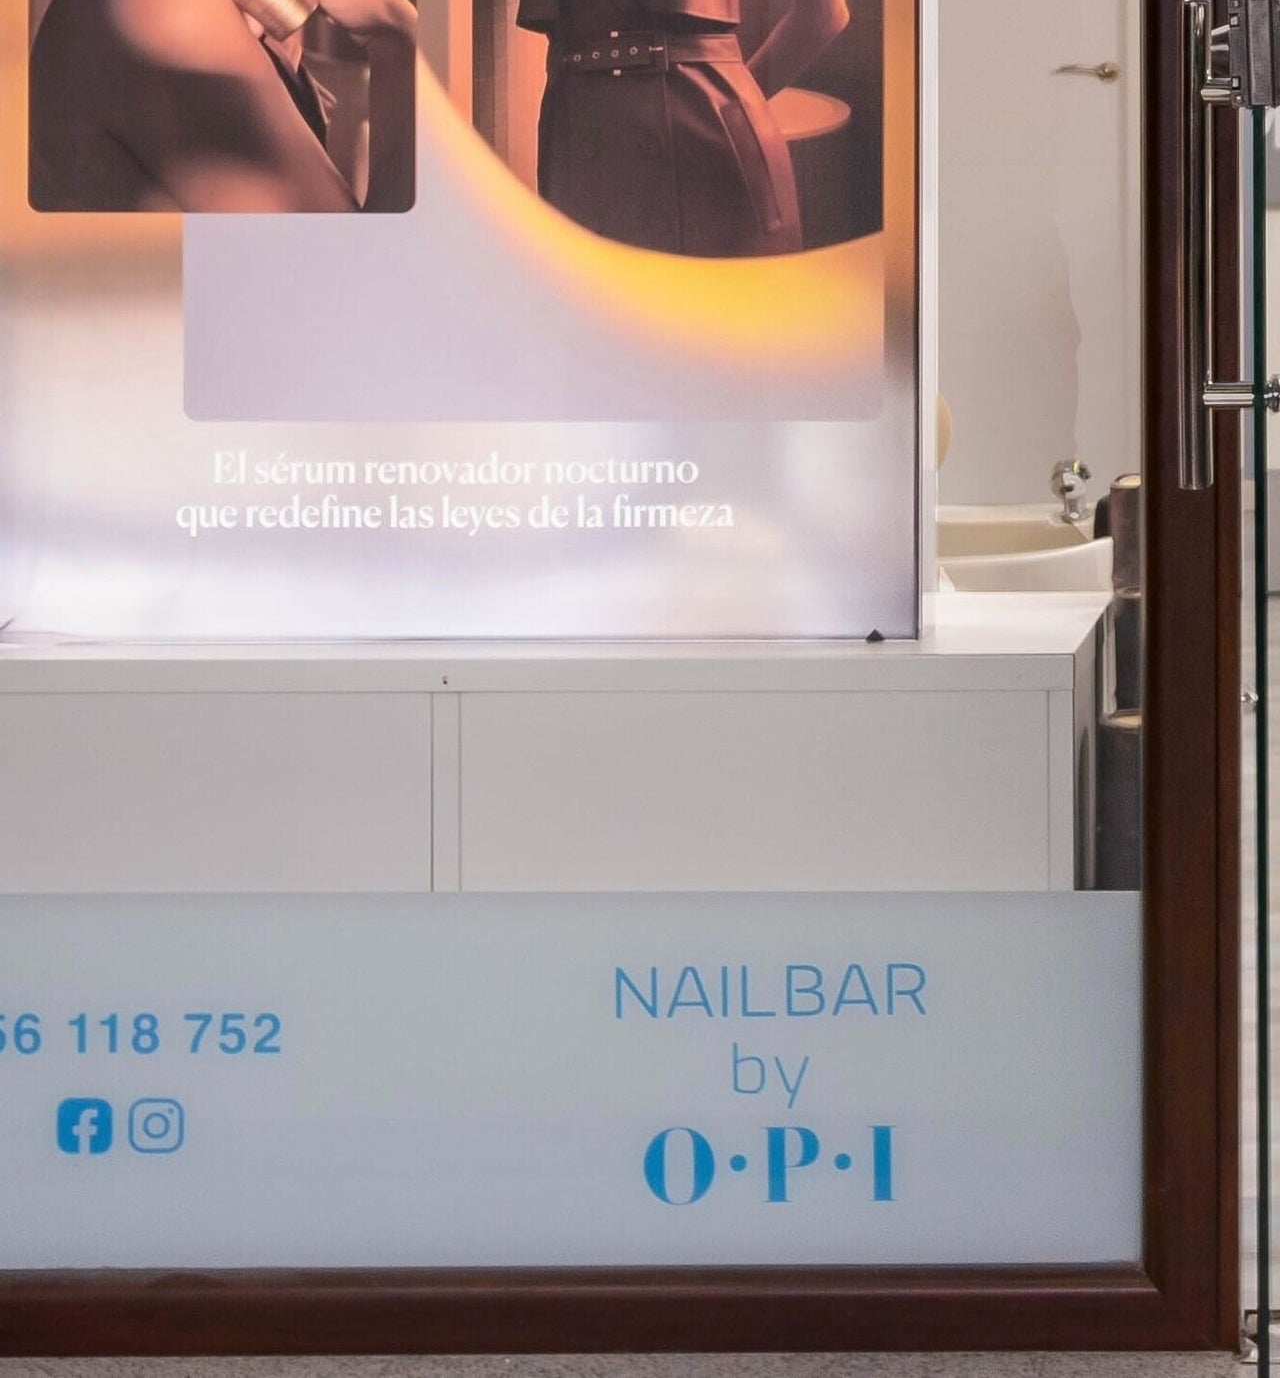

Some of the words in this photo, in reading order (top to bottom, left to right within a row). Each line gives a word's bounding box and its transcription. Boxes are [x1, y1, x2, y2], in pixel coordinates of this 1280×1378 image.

[212, 450, 246, 485] El
[254, 452, 357, 485] sérum
[364, 451, 538, 485] renovador
[543, 456, 700, 485] nocturno
[175, 503, 238, 538] que
[246, 494, 382, 528] redefine
[390, 494, 434, 528] las
[441, 494, 521, 537] leyes
[528, 494, 570, 528] de
[577, 494, 604, 528] la
[612, 494, 735, 528] firmeza
[614, 962, 927, 1019] NAILBAR
[67, 1012, 160, 1055] 118
[183, 1012, 282, 1055] 752
[732, 1041, 810, 1109] by
[643, 1124, 898, 1206] O·P·I
